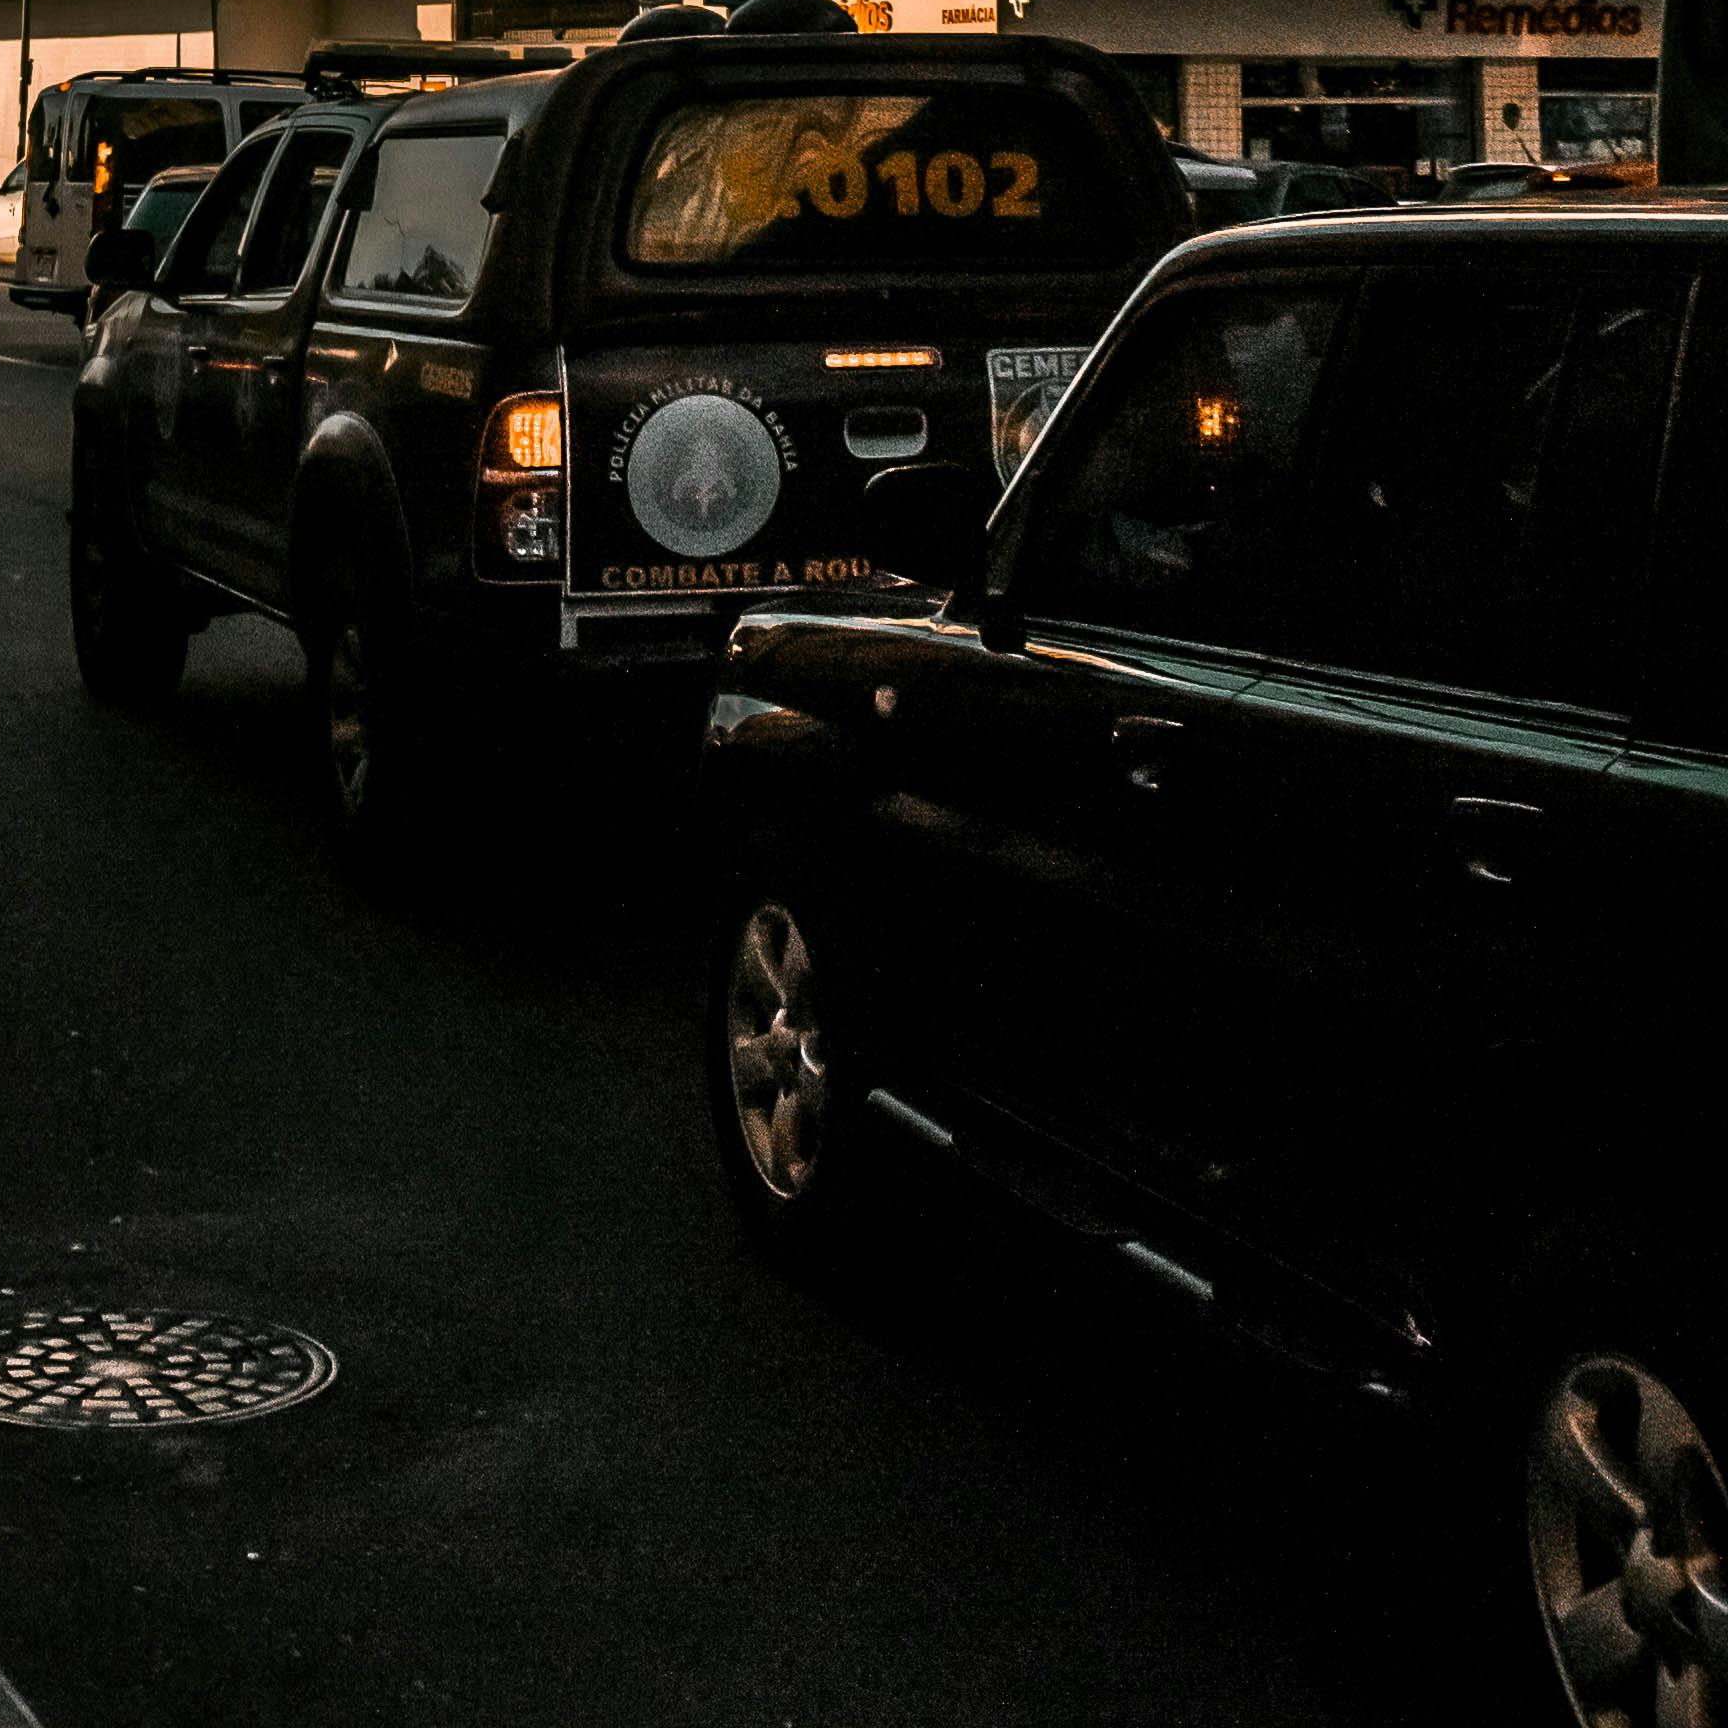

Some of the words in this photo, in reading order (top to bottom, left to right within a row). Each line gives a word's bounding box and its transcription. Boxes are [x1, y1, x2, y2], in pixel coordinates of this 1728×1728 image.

[942, 2, 995, 25] FARMÁCIA
[992, 352, 1088, 381] GEME
[739, 385, 763, 411] DA
[600, 560, 763, 590] COMBATE
[773, 559, 793, 585] A
[802, 556, 873, 585] ROU
